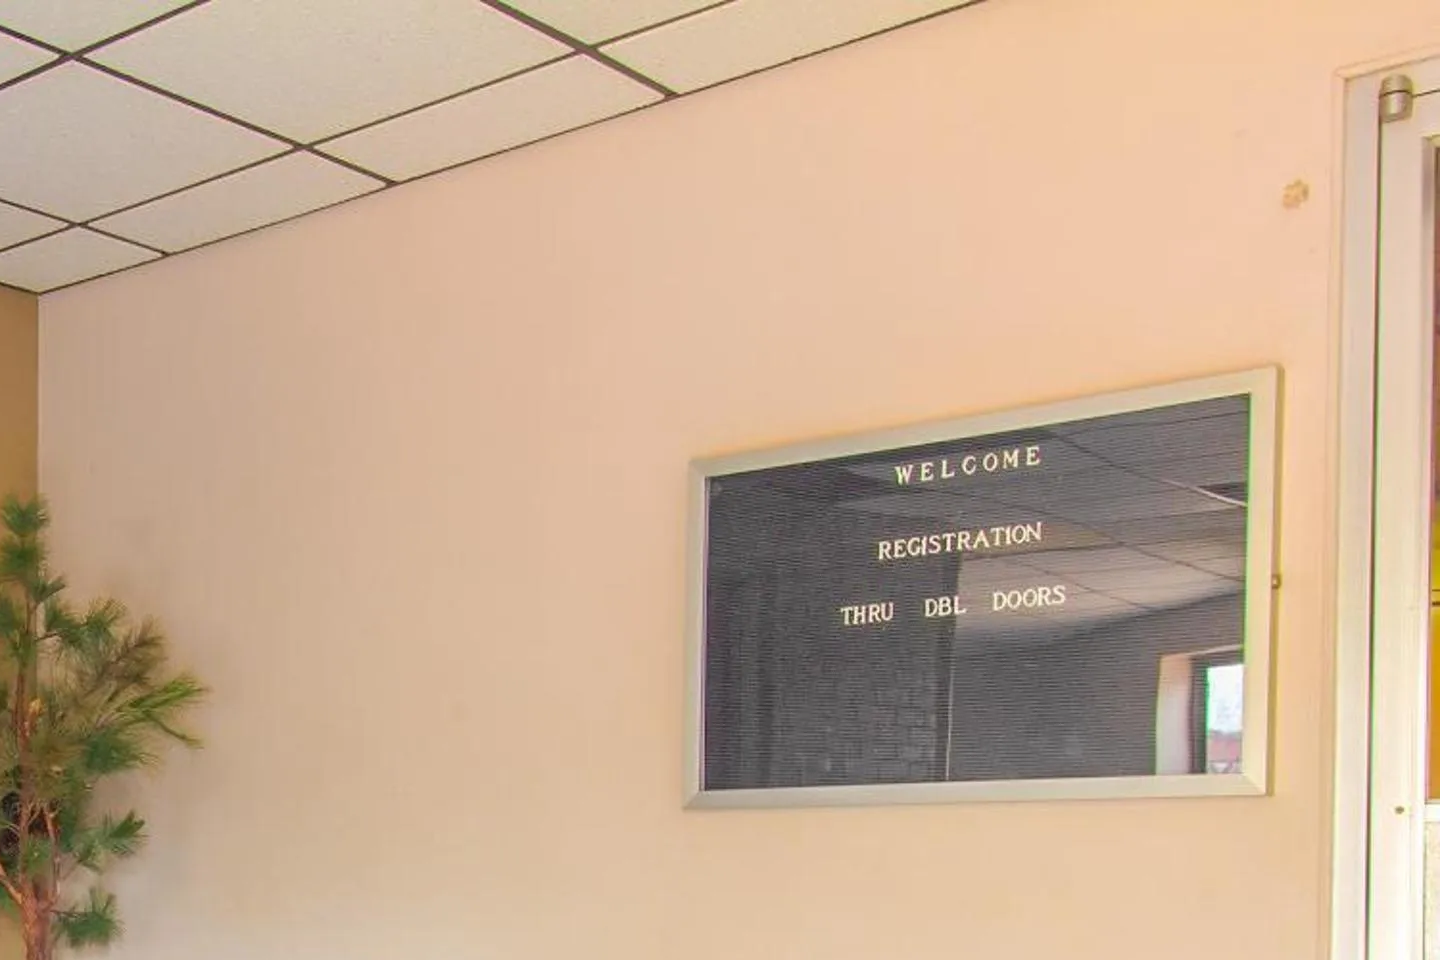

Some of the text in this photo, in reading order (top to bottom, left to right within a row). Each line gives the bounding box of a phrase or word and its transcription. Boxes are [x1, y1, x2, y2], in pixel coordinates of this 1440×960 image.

[894, 446, 1041, 485] WELCOME
[878, 522, 1042, 560] REGISTRATION
[840, 585, 1066, 625] THRU DBL DOORS
